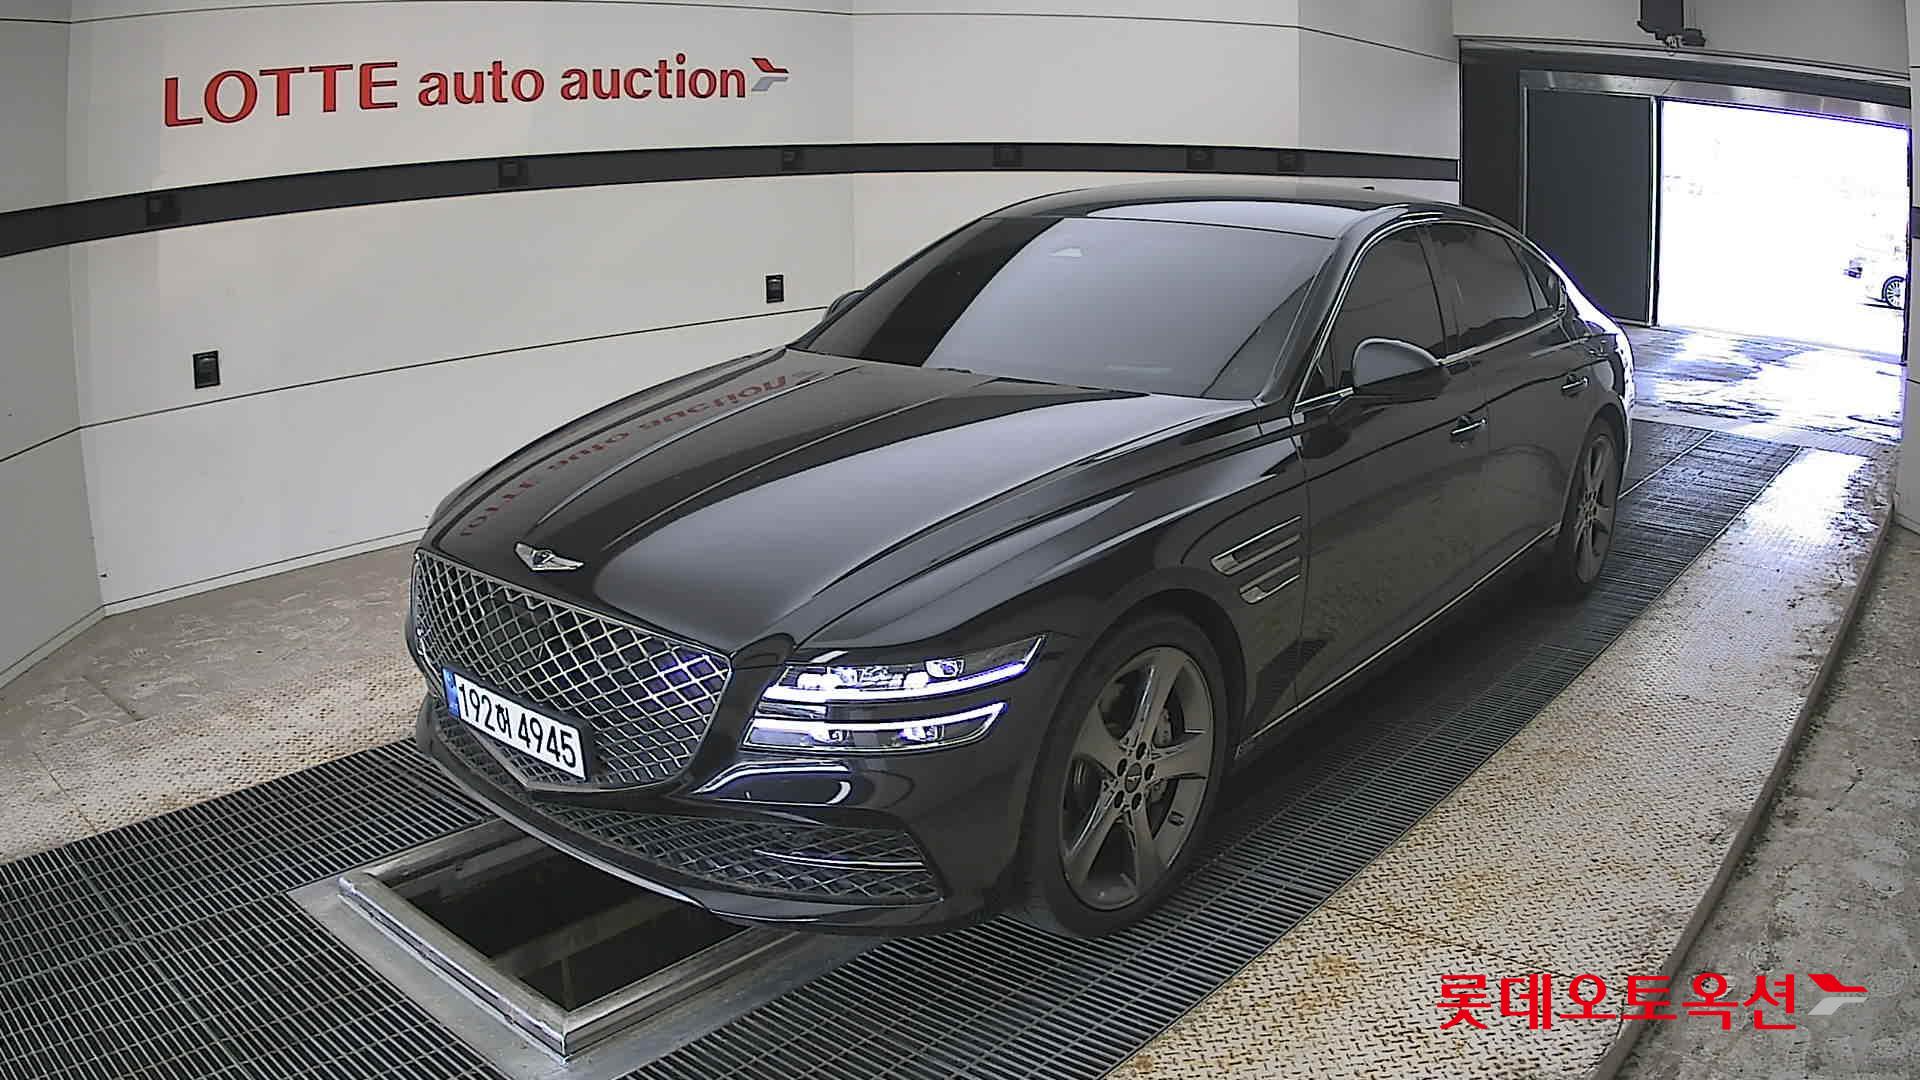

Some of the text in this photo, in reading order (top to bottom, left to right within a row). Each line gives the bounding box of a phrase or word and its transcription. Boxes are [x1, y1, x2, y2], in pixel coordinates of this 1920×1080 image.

[164, 53, 746, 127] LOTTE auto auction
[459, 684, 576, 768] 192허 4945
